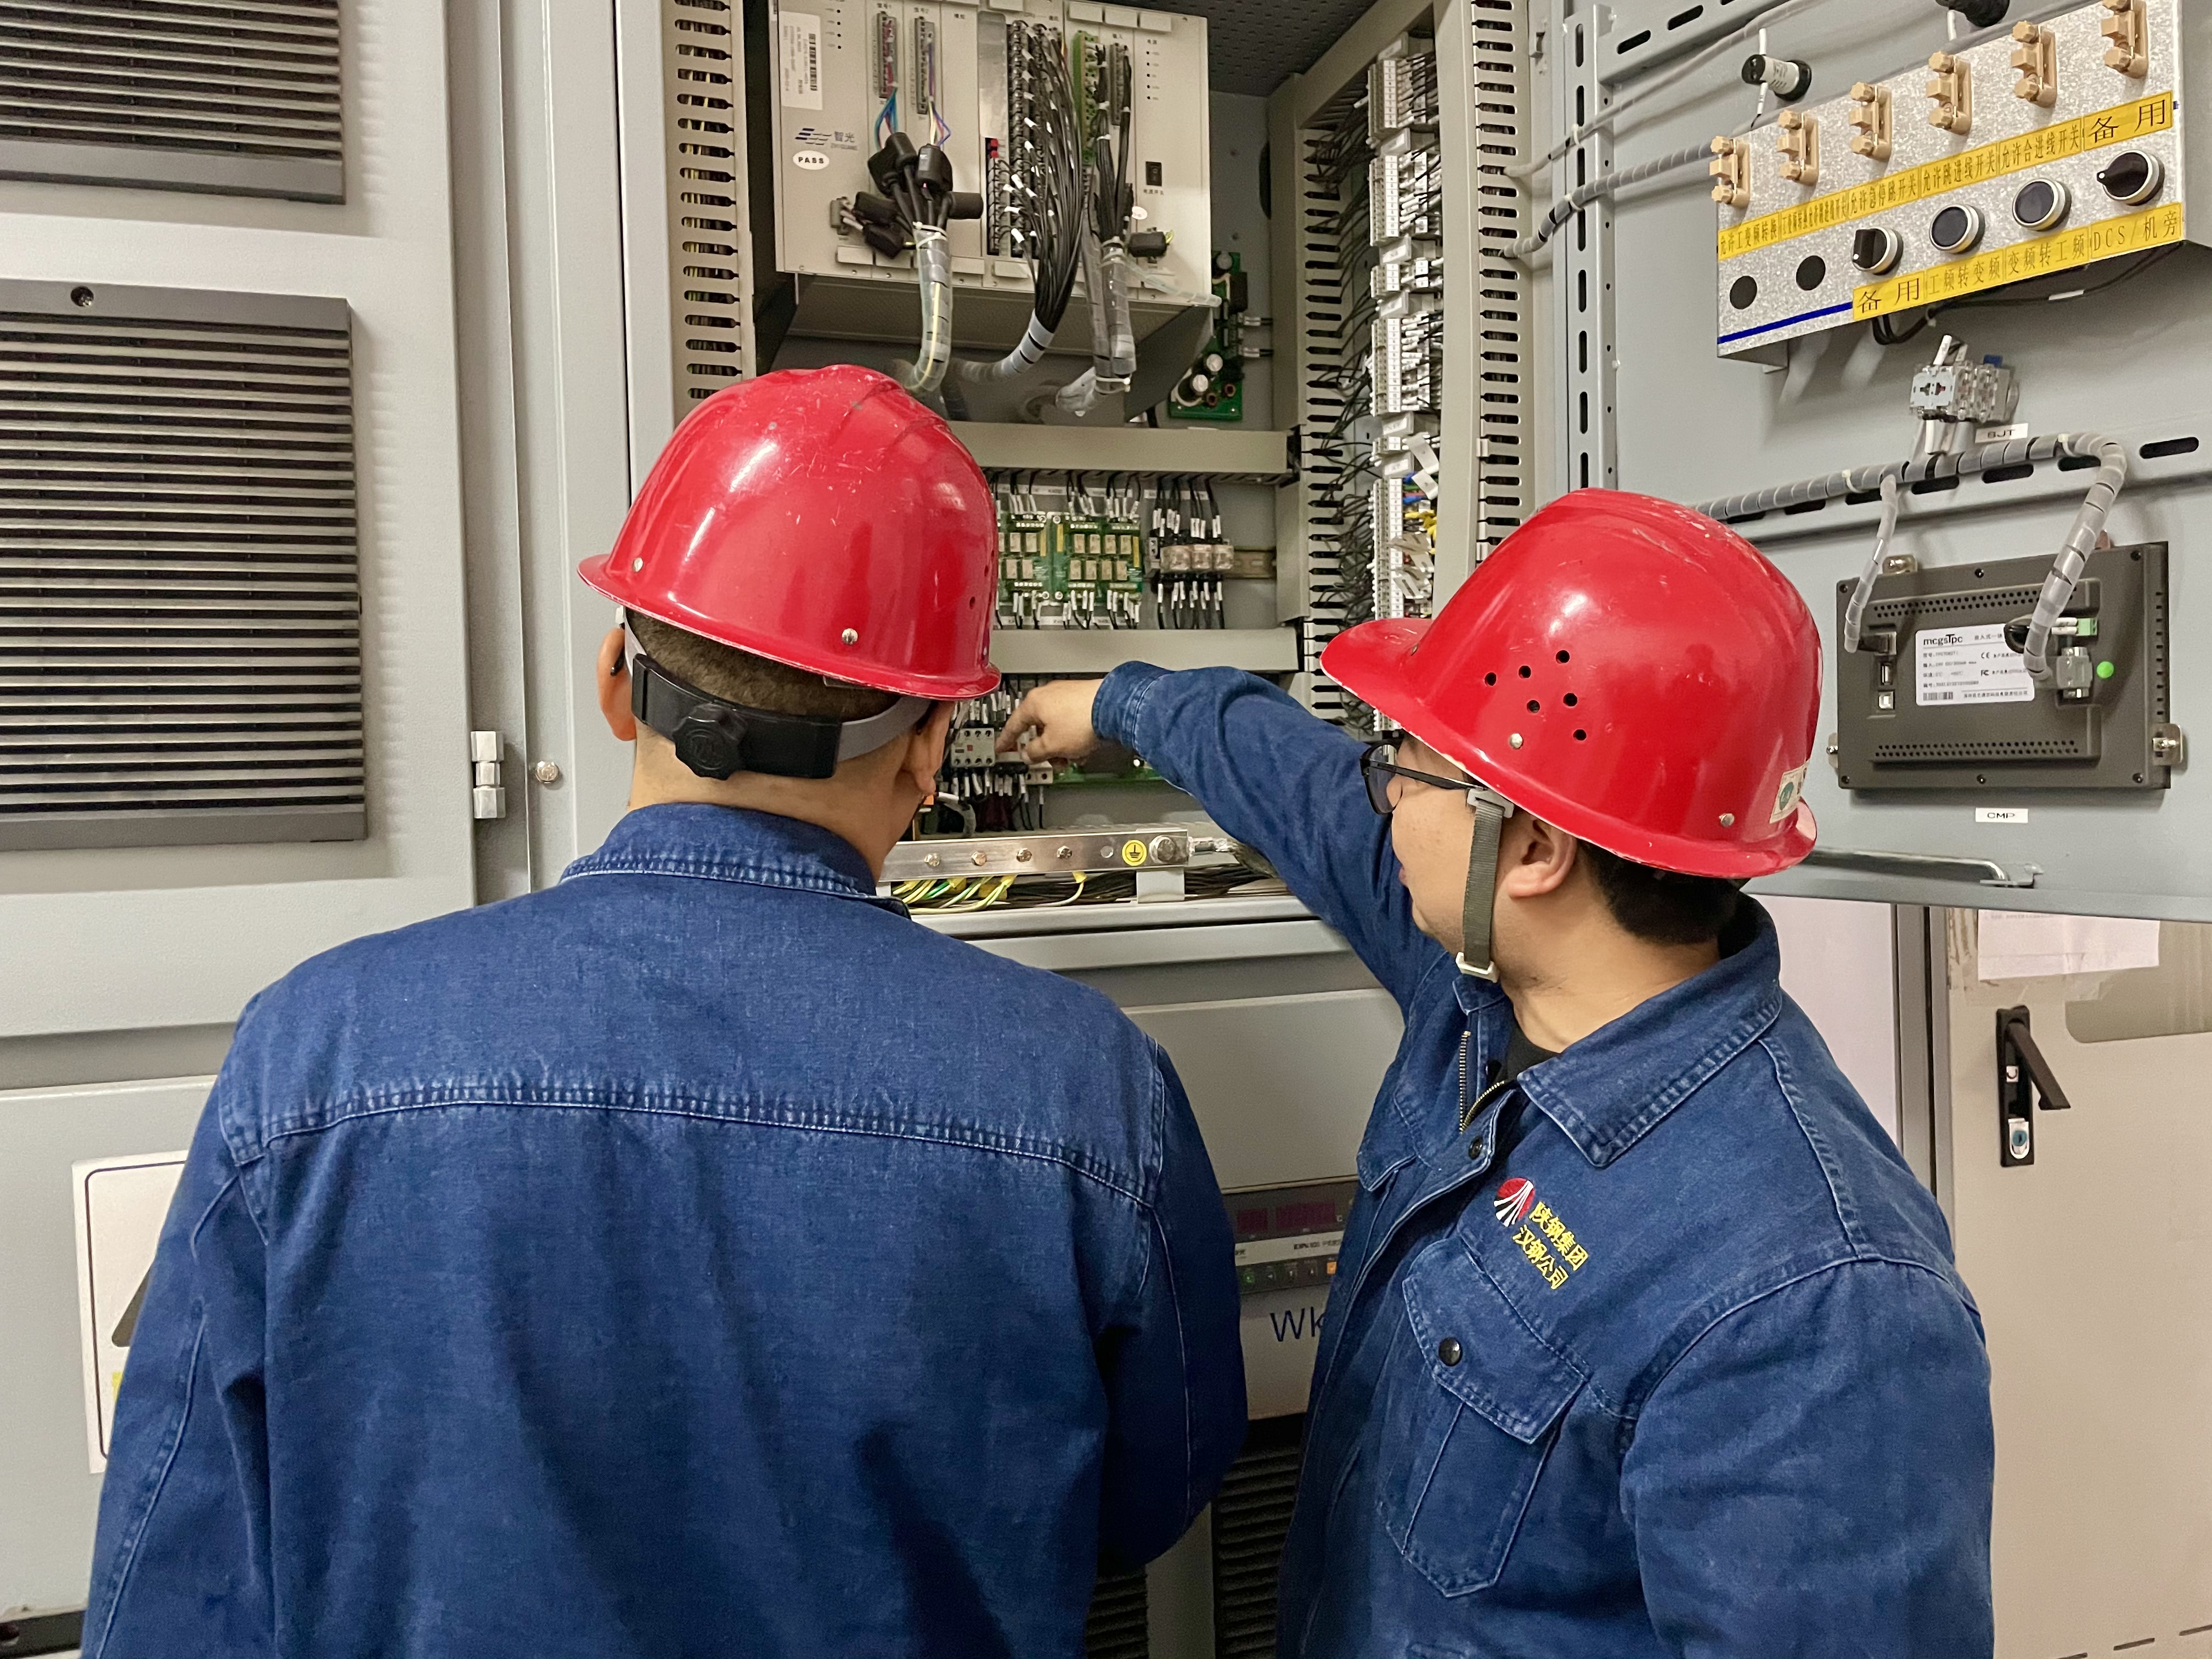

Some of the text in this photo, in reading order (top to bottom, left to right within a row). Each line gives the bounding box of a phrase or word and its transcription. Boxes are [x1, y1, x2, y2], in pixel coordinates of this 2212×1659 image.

[2089, 99, 2165, 143] 备用
[2001, 125, 2079, 170] 允许合进线开关
[1923, 149, 1995, 194] 允许跳进线开关
[1850, 173, 1916, 215] 允许急停跳开关
[1928, 256, 2000, 295] 工频转变频
[2008, 233, 2085, 275] 变频转工频
[1857, 278, 1919, 313] 备用
[1512, 1224, 1570, 1290] 汉钢公司
[1528, 1201, 1589, 1271] 陕钢集团
